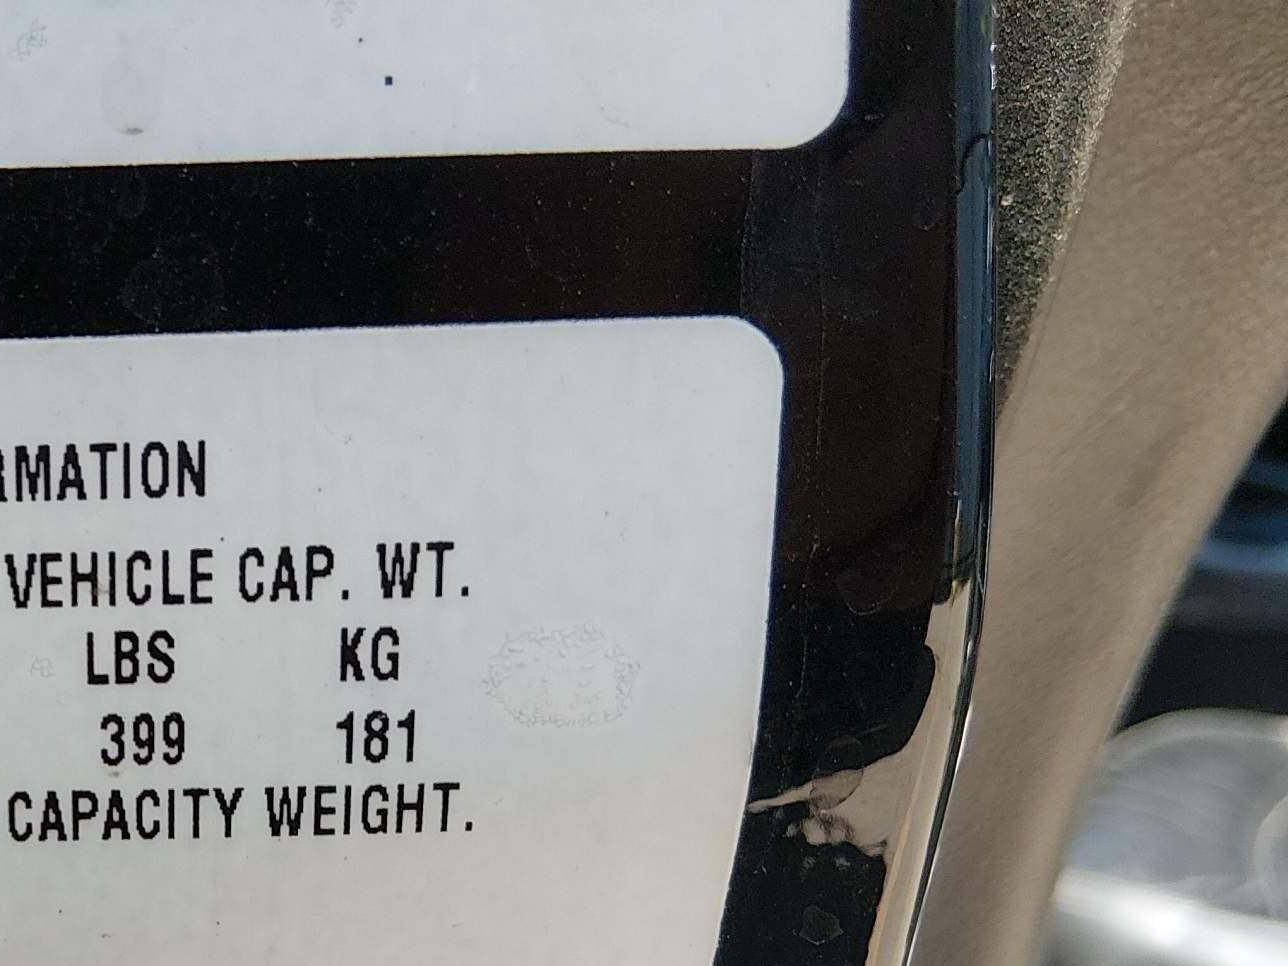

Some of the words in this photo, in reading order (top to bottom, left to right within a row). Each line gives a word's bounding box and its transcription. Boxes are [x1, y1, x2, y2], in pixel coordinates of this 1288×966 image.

[4, 547, 214, 610] VEHICLE
[238, 544, 350, 604] CAP.
[375, 540, 469, 600] WT.
[86, 629, 176, 686] LBS
[339, 626, 400, 683] KG
[100, 711, 186, 767] 399
[335, 708, 416, 765] 181
[7, 787, 245, 843] CAPACITY
[264, 781, 473, 837] WEIGHT.
